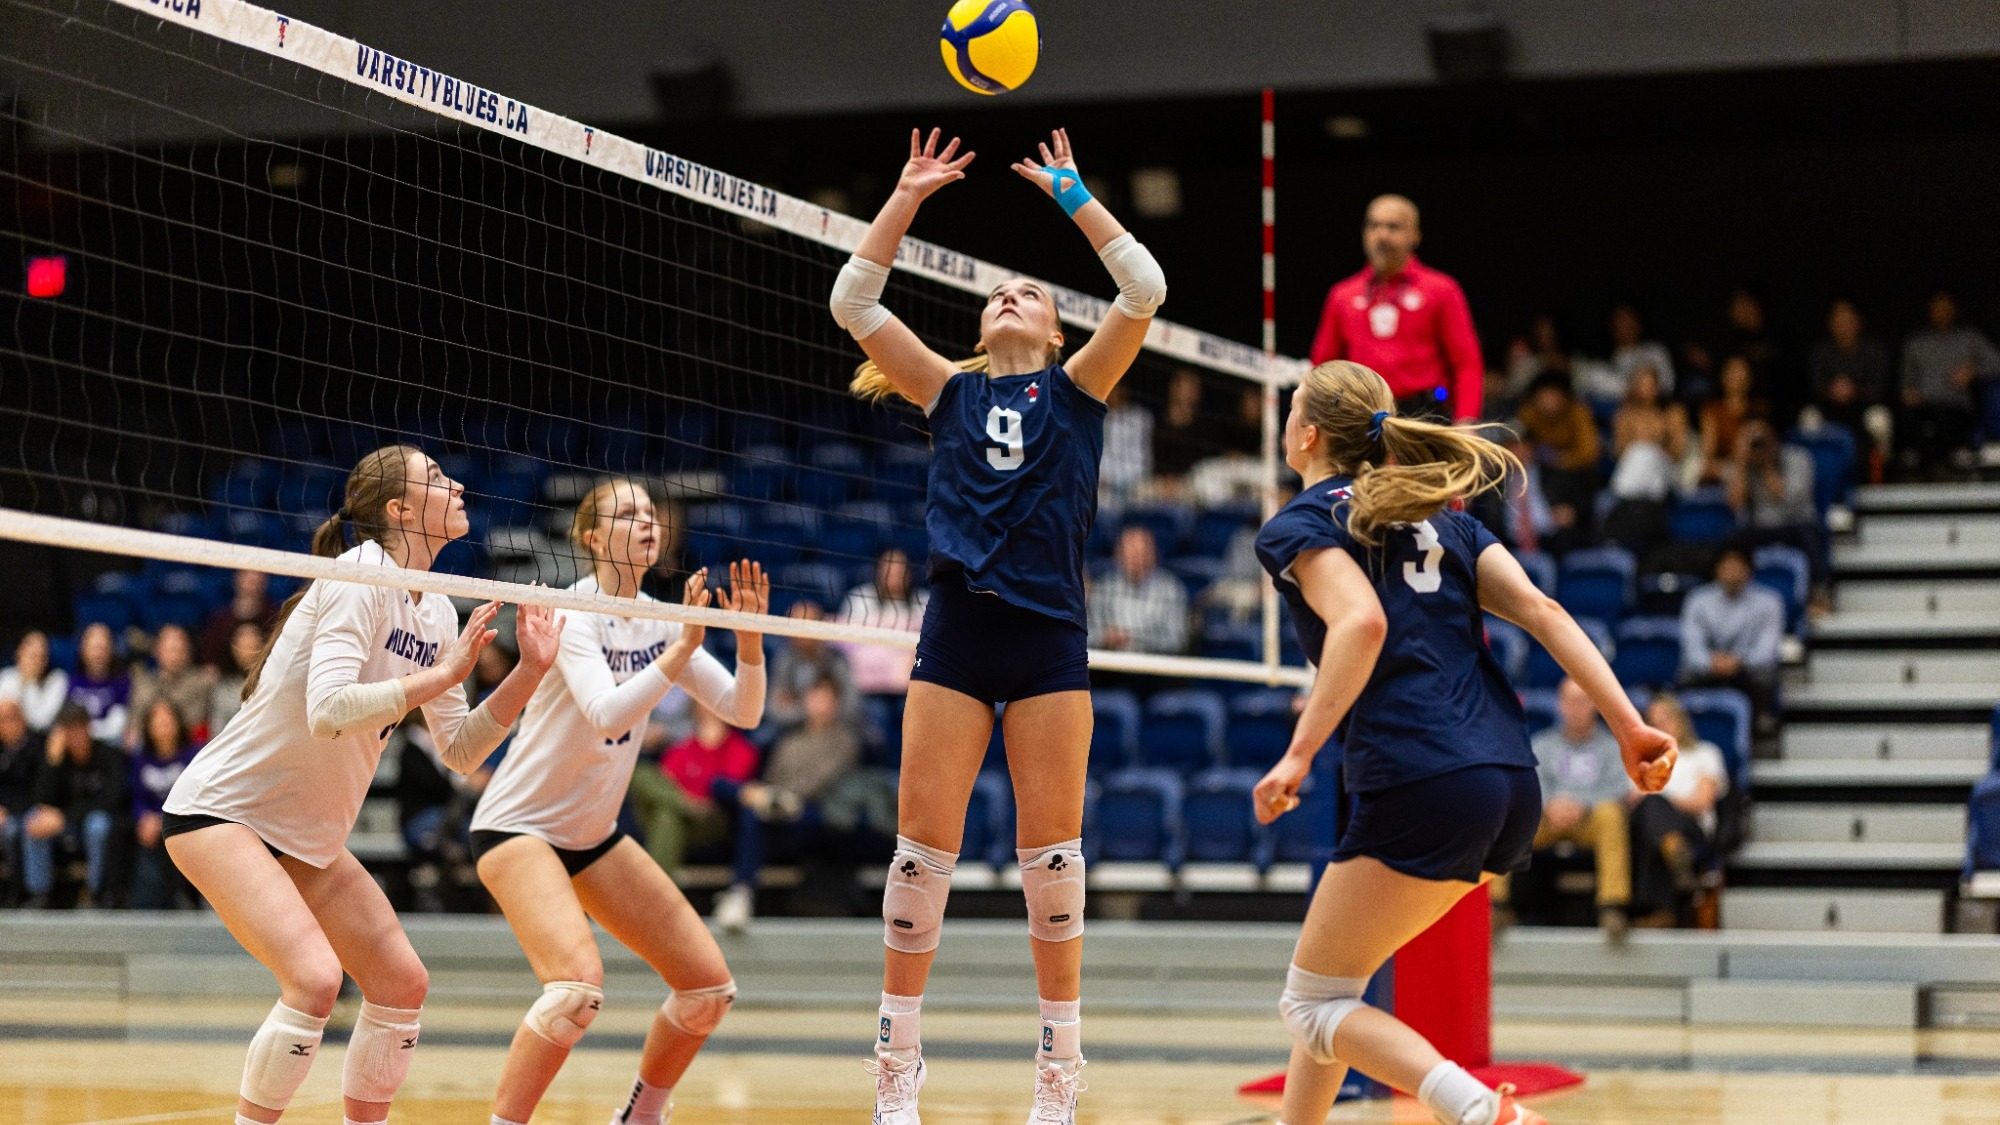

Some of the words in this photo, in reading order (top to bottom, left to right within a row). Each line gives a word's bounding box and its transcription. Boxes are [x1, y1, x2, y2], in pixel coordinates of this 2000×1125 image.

[356, 44, 529, 135] VARSITYBLUES.CA
[645, 149, 777, 217] VARSITYBLUES.CA
[986, 405, 1025, 471] 9
[1402, 519, 1445, 593] 3
